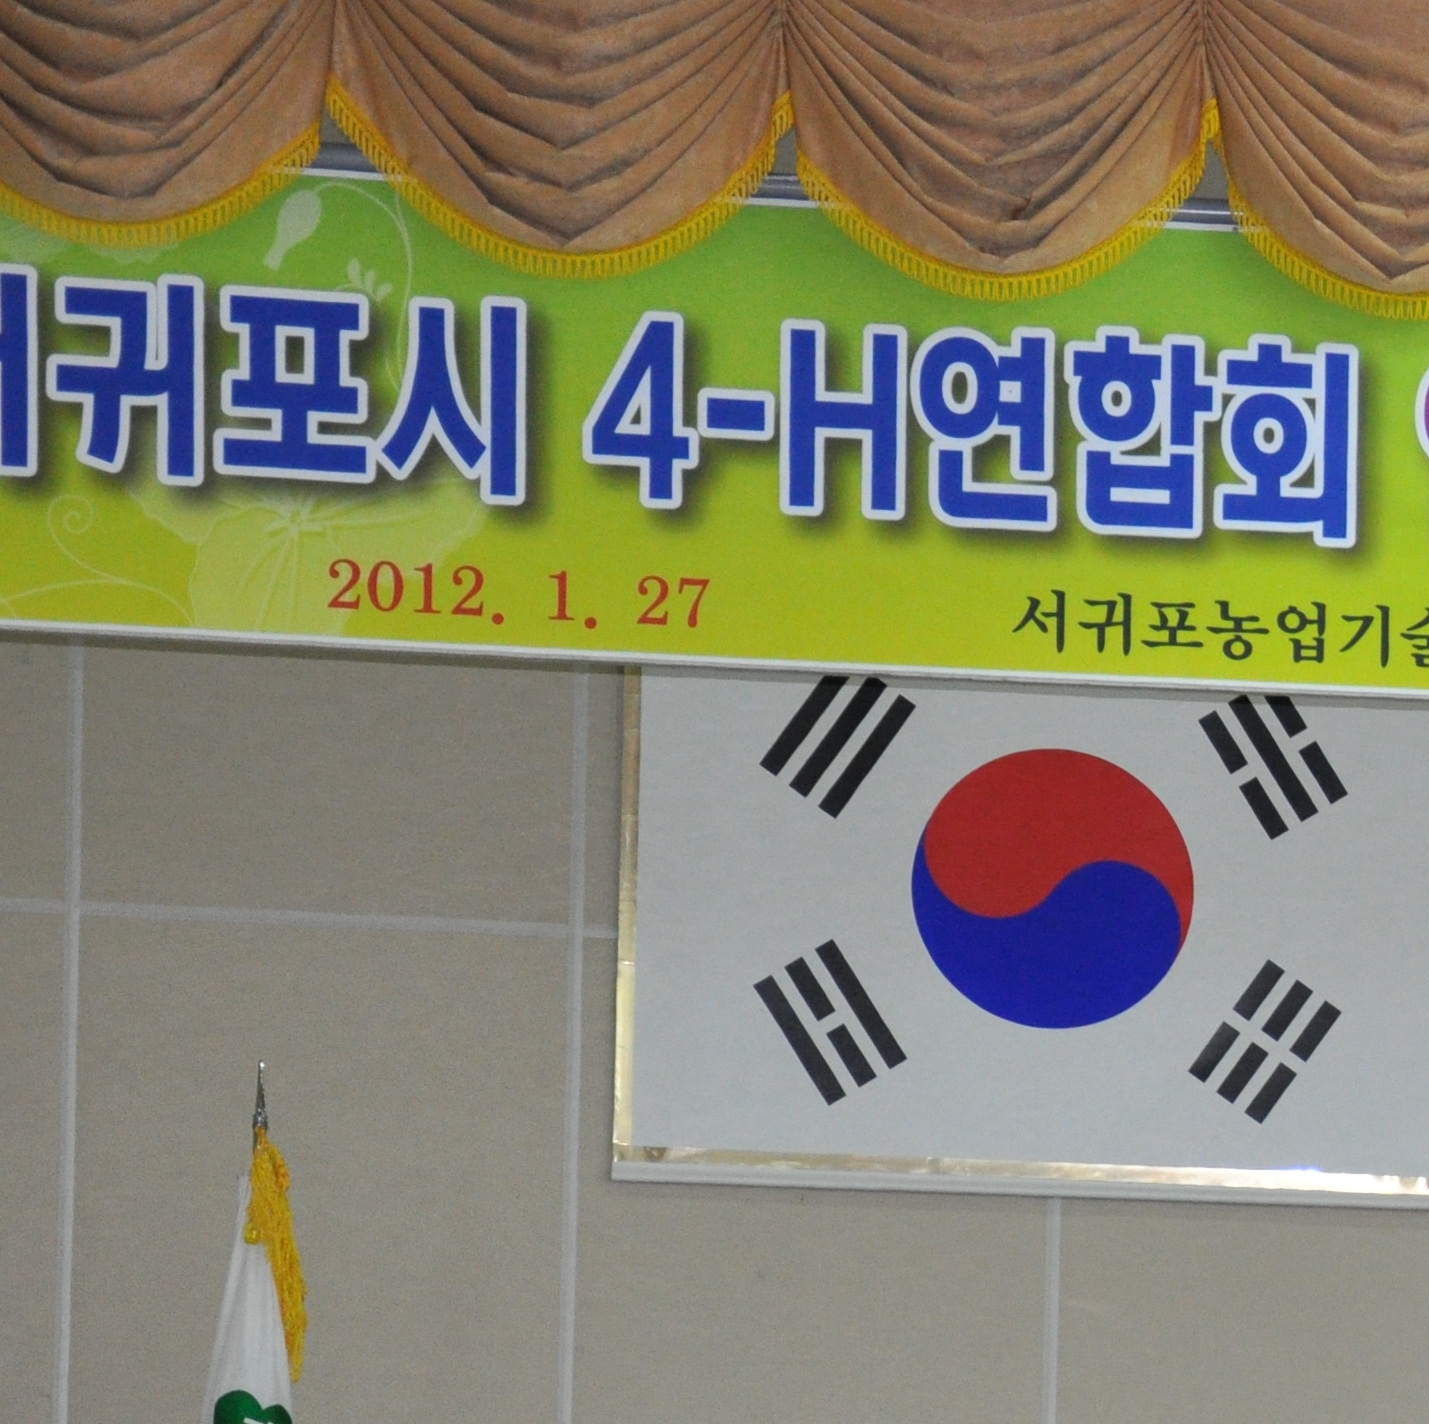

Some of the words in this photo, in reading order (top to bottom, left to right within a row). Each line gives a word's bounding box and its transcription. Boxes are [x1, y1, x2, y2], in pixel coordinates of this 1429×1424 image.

[0, 262, 528, 507] 귀포시
[583, 309, 1360, 549] 4-H연합회
[327, 558, 505, 627] 2012.
[546, 571, 599, 631] 1.
[636, 576, 711, 630] 27
